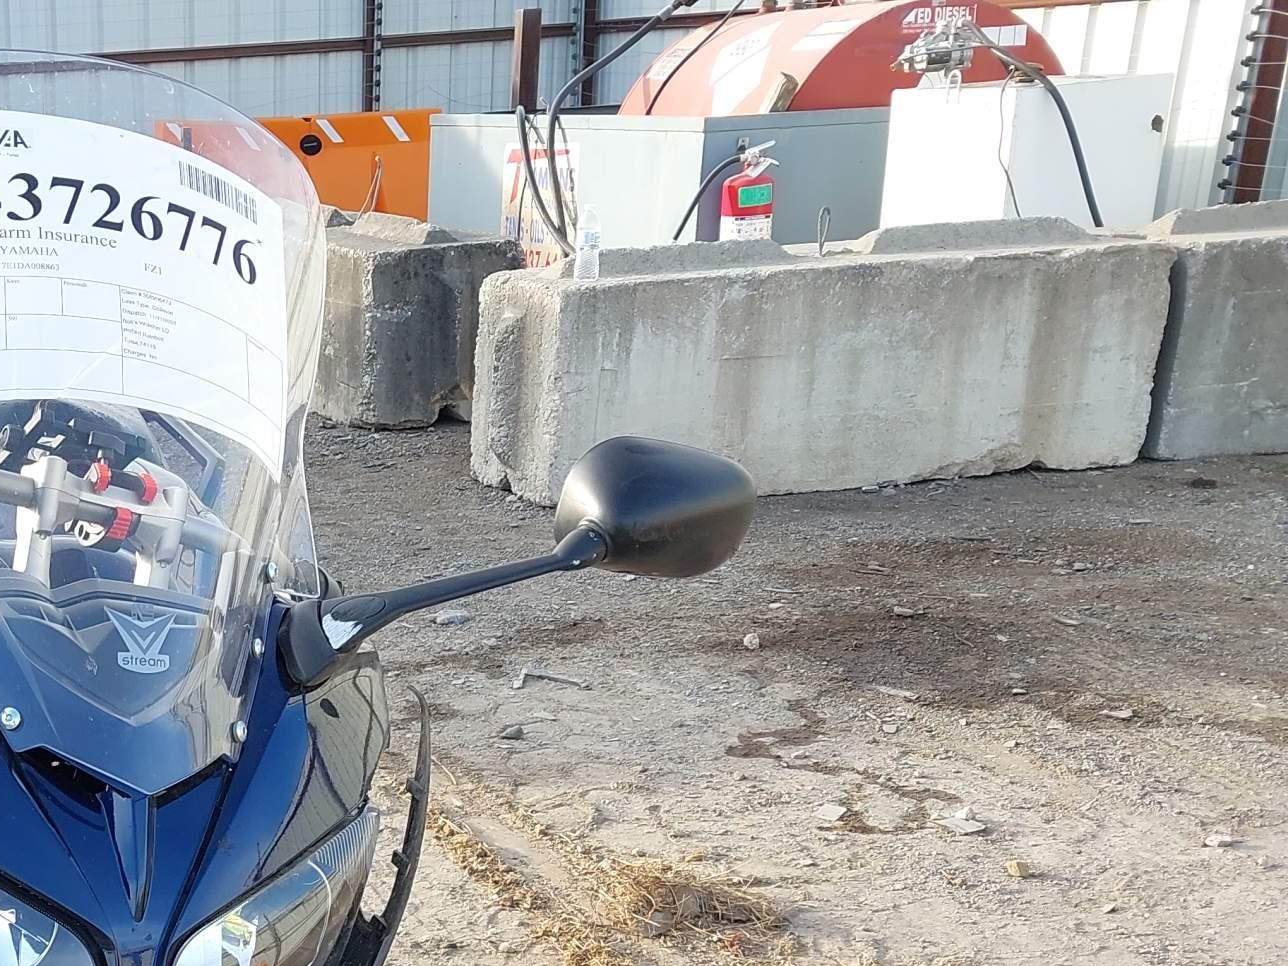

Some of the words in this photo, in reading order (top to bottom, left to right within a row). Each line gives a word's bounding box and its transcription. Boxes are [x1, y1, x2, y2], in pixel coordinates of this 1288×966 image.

[38, 226, 118, 249] Insurance
[0, 246, 59, 257] YAMAHA
[122, 656, 166, 668] stream
